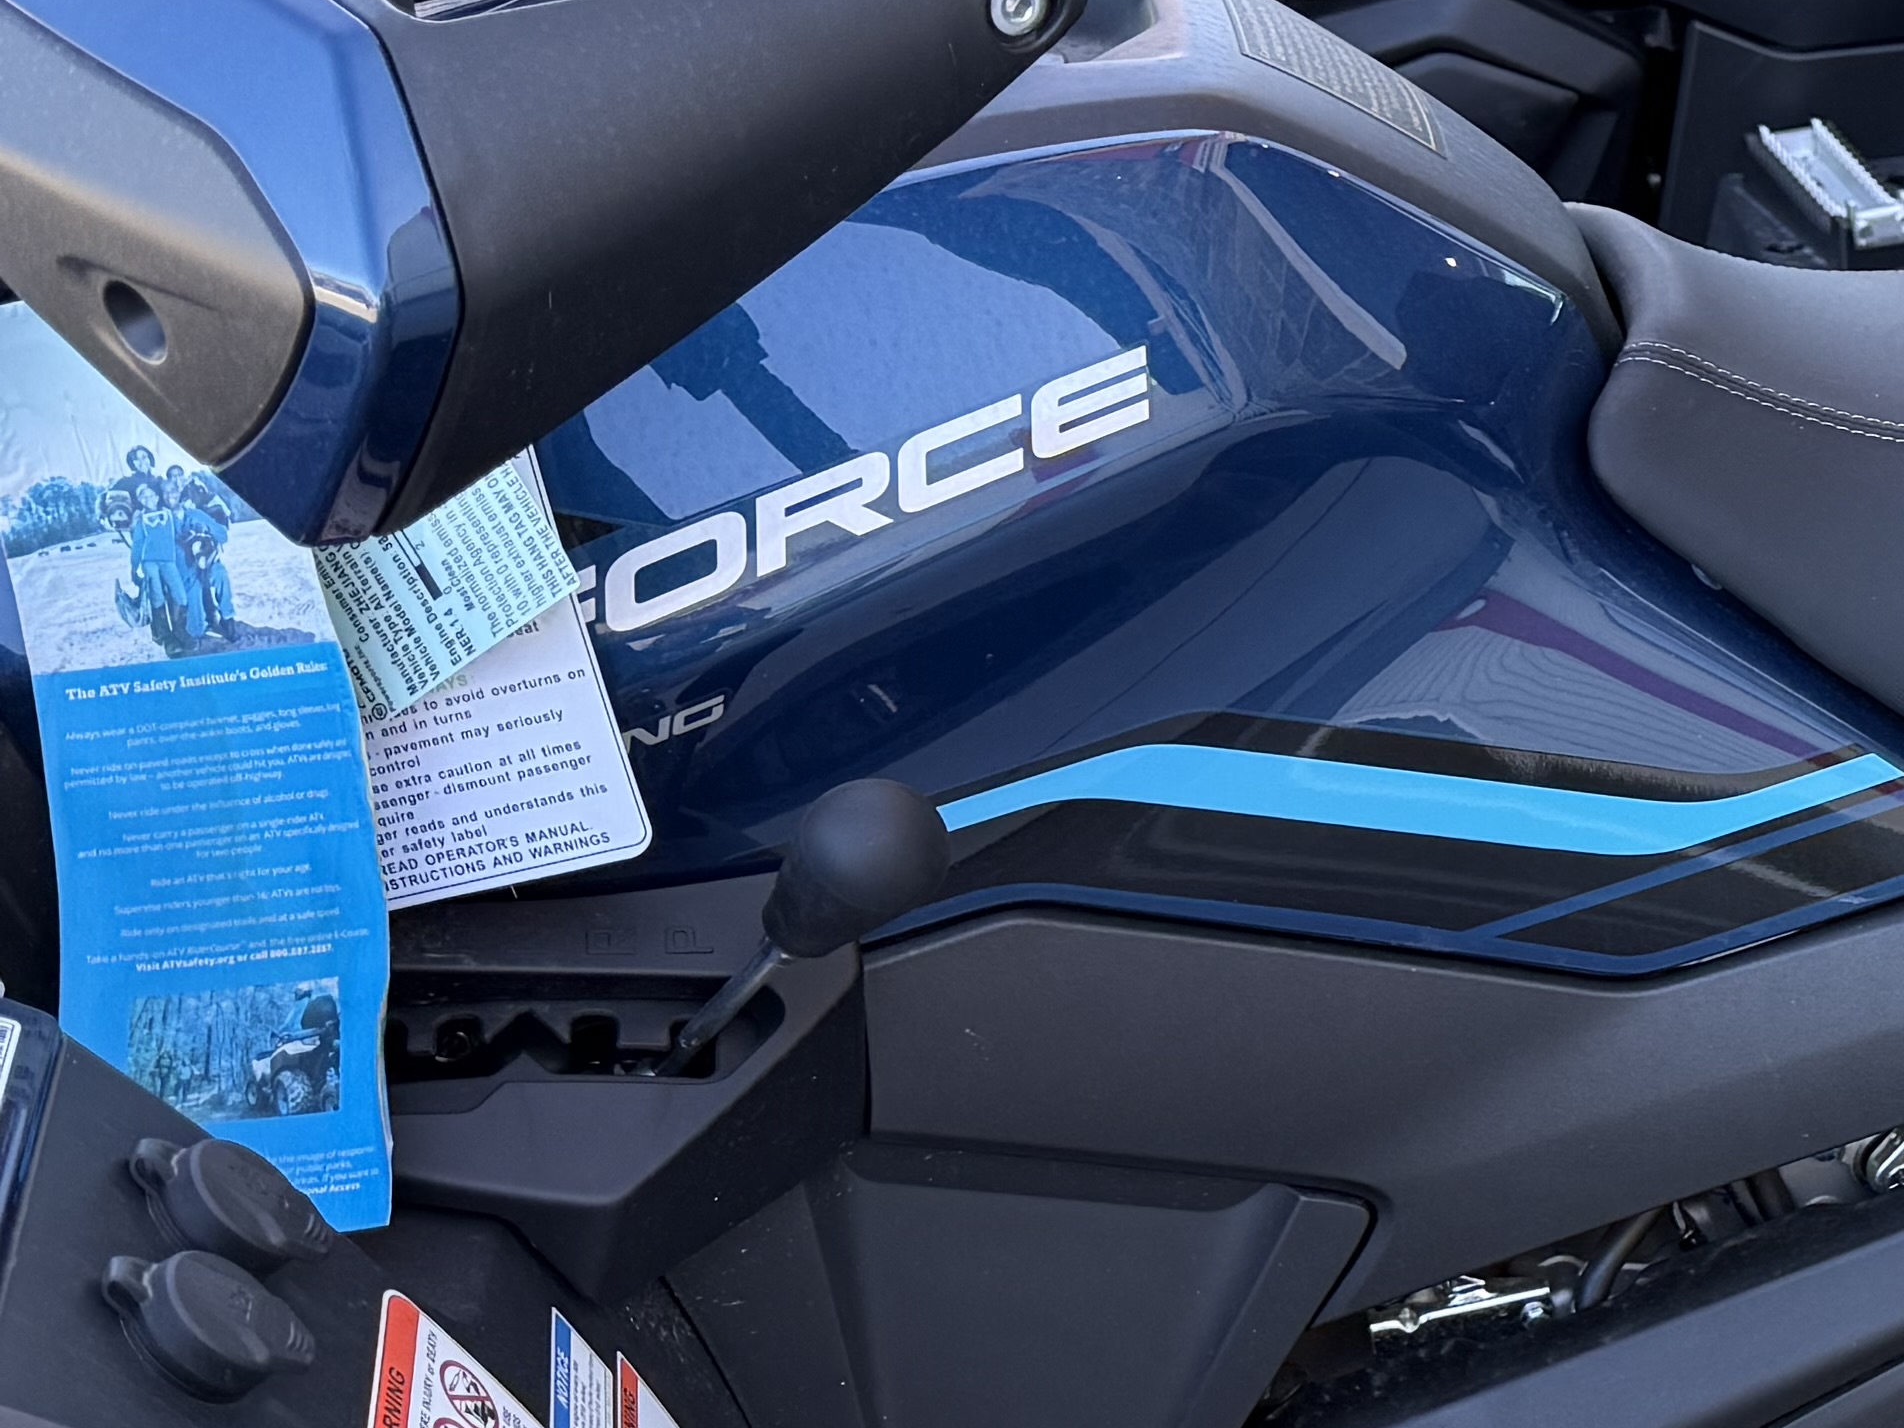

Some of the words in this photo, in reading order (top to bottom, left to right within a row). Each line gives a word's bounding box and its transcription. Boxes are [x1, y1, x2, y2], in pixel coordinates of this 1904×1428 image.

[443, 509, 458, 524] in
[492, 486, 515, 514] MAY
[506, 475, 544, 527] VEHICLE
[451, 519, 488, 568] Agency
[507, 510, 529, 537] TAG
[535, 525, 556, 550] THE
[414, 539, 425, 550] 2
[490, 520, 526, 570] exhaust
[521, 535, 549, 570] HANG
[323, 549, 370, 616] ZHEJIANG
[340, 549, 373, 595] Terrain
[438, 557, 461, 587] Clean
[445, 546, 492, 613] normalized
[517, 566, 550, 607] higher
[540, 567, 564, 597] THIS
[549, 548, 578, 586] AFTER
[330, 585, 370, 643] Consumer
[367, 592, 384, 612] All
[455, 586, 475, 611] Most
[476, 565, 519, 627] Protection
[387, 599, 416, 637] Model
[482, 610, 506, 637] The
[409, 635, 442, 680] Vehicle
[431, 621, 465, 665] Engine
[66, 687, 95, 701] The
[99, 681, 130, 697] ATV
[133, 676, 176, 696] Safety
[179, 667, 247, 688] Institute's
[249, 663, 294, 680] Golden
[398, 643, 431, 688] Vehicle
[424, 698, 438, 710] to
[445, 688, 485, 706] avoid
[492, 673, 561, 696] overturns
[568, 668, 585, 679] on
[381, 722, 407, 737] and
[414, 718, 427, 730] in
[434, 710, 472, 726] turns
[384, 732, 455, 759] pavement
[461, 725, 490, 740] may
[497, 708, 563, 732] seriously
[395, 774, 432, 790] extra
[438, 759, 492, 780] caution
[499, 754, 513, 766] at
[518, 749, 536, 764] all
[542, 739, 582, 758] times
[443, 772, 511, 796] dismount
[517, 753, 592, 782] passenger
[405, 820, 445, 837] reads
[452, 811, 478, 825] and
[484, 790, 574, 818] understands
[580, 782, 608, 799] this
[402, 833, 446, 854] safety
[452, 825, 488, 844] label
[426, 836, 519, 866] OPERATOR'S
[525, 820, 594, 844] MANUAL.
[492, 851, 523, 868] AND
[530, 832, 610, 859] WARNINGS
[136, 961, 159, 973] Visit
[161, 952, 235, 972] ATVsafety.org
[236, 953, 248, 961] or
[249, 949, 268, 961] call
[556, 1346, 569, 1408] NOTICE
